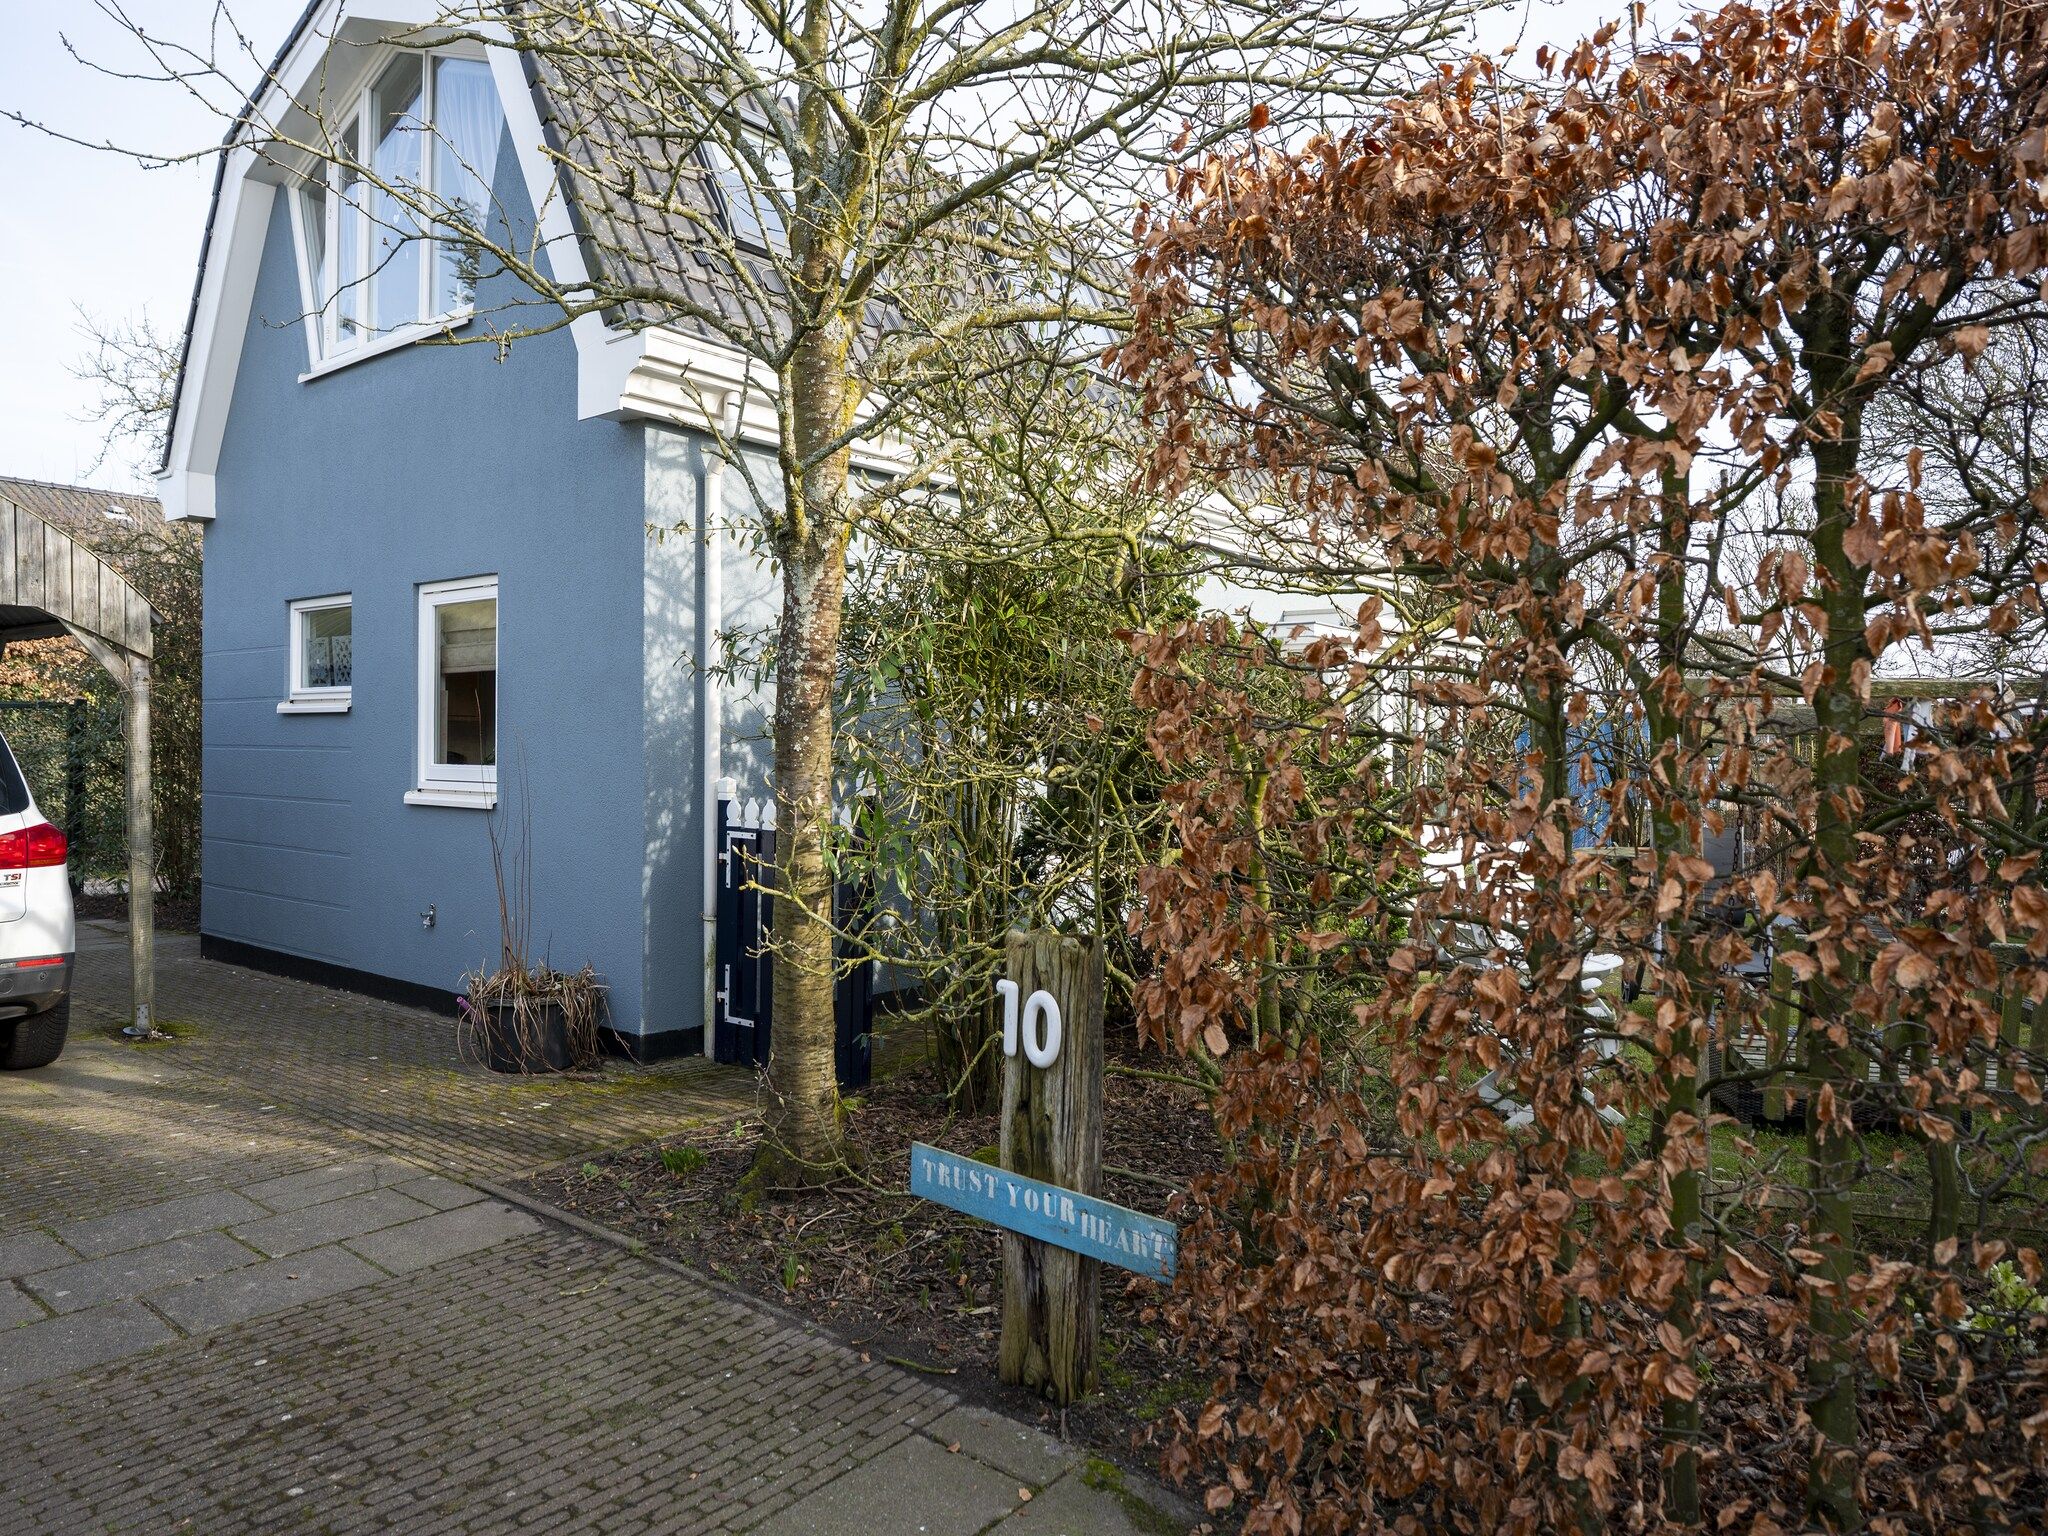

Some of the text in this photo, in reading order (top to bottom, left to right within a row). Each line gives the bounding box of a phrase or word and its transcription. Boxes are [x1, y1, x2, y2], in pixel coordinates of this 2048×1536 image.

[4, 873, 21, 881] TSI
[996, 979, 1061, 1068] 10
[922, 1158, 1168, 1261] TRUST YOUR HEART
